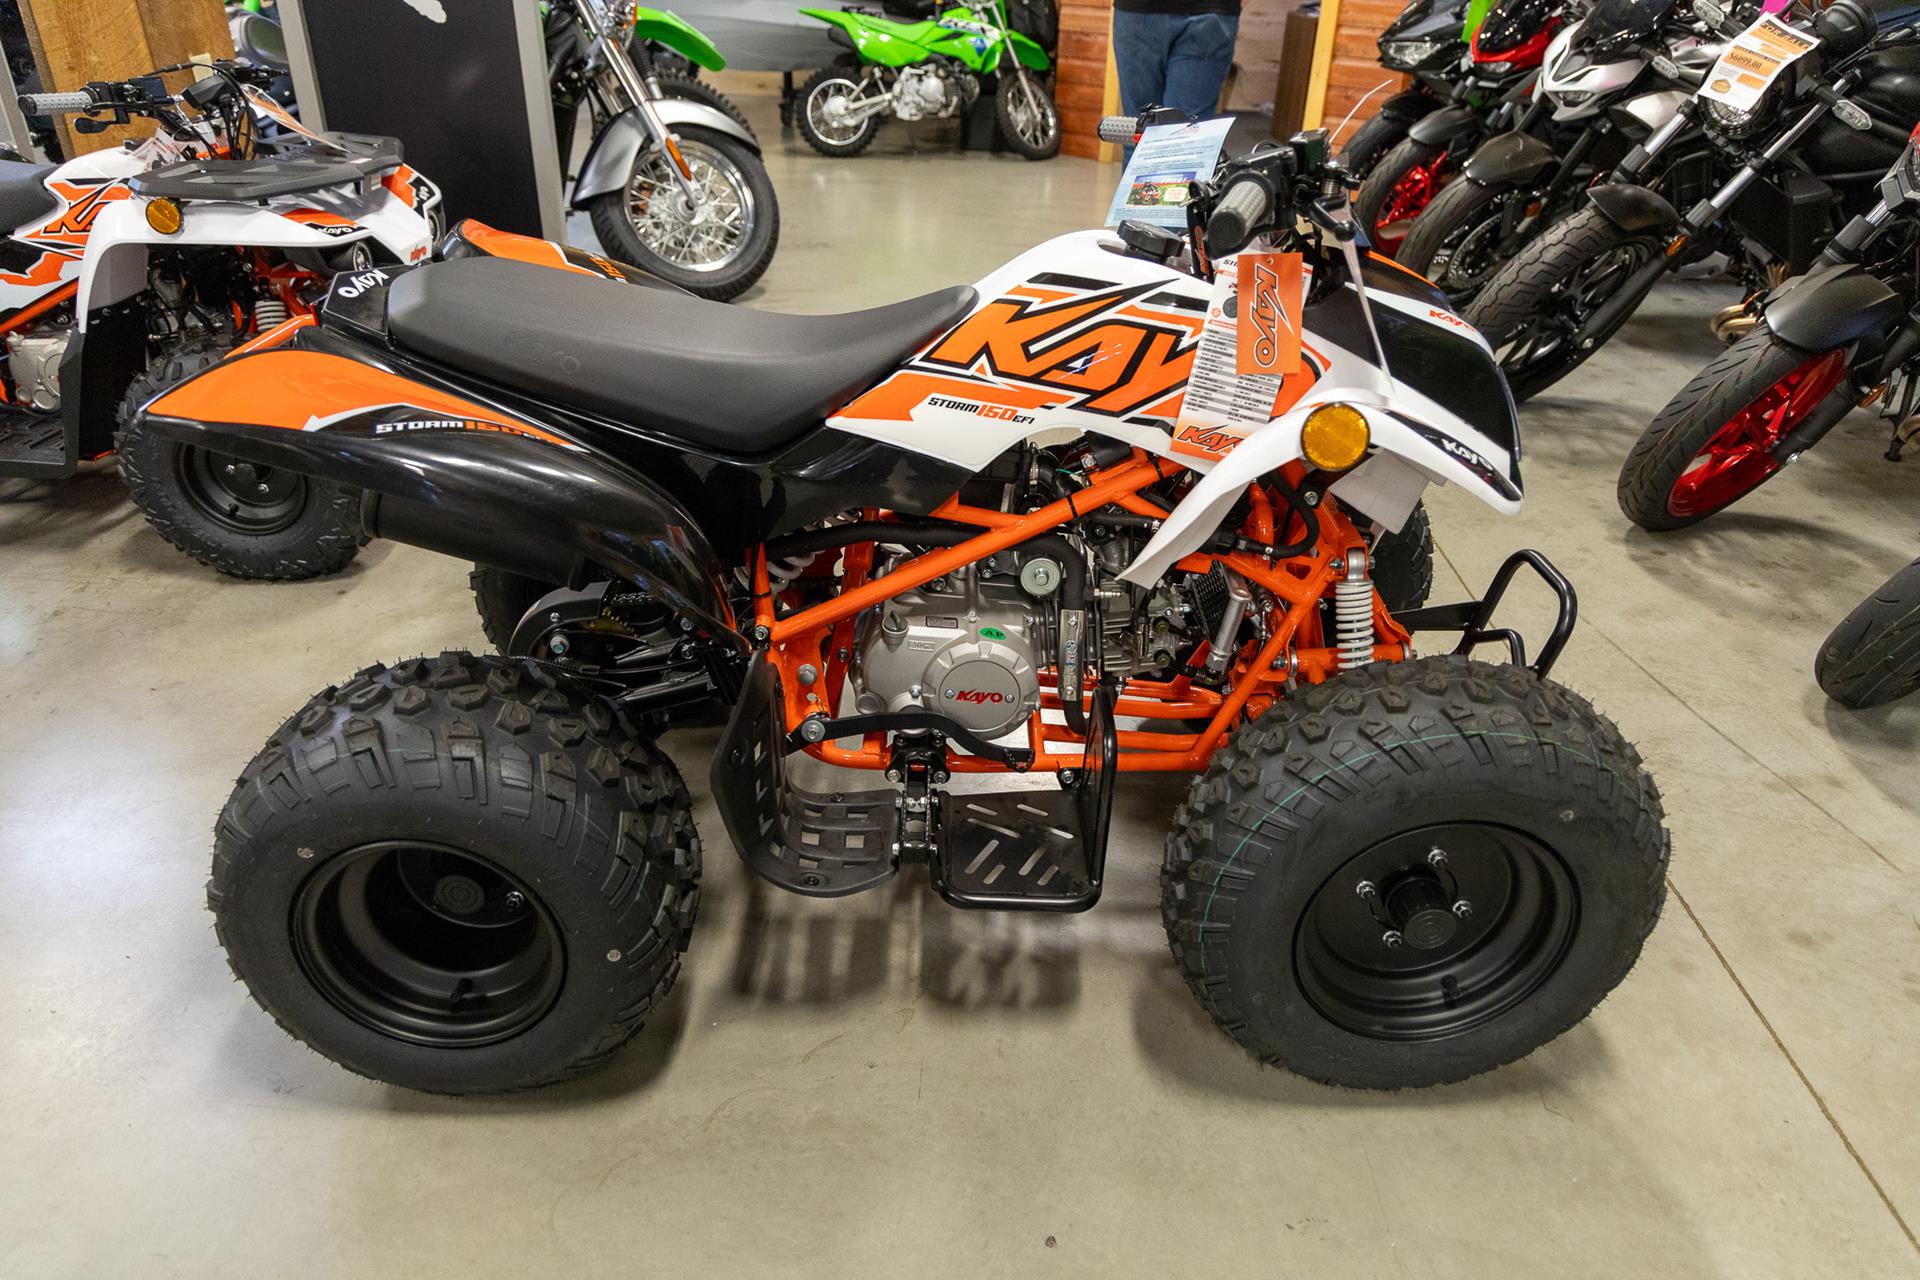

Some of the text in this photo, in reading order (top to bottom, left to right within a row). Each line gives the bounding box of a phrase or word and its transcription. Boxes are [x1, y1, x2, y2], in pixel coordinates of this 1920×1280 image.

[337, 269, 390, 298] KAYO
[1250, 262, 1294, 368] KAYO
[1429, 309, 1477, 333] KAYO
[919, 278, 1321, 420] KAY
[1176, 424, 1246, 452] KAY
[1441, 438, 1494, 471] KAYO
[956, 688, 1003, 705] KAYO
